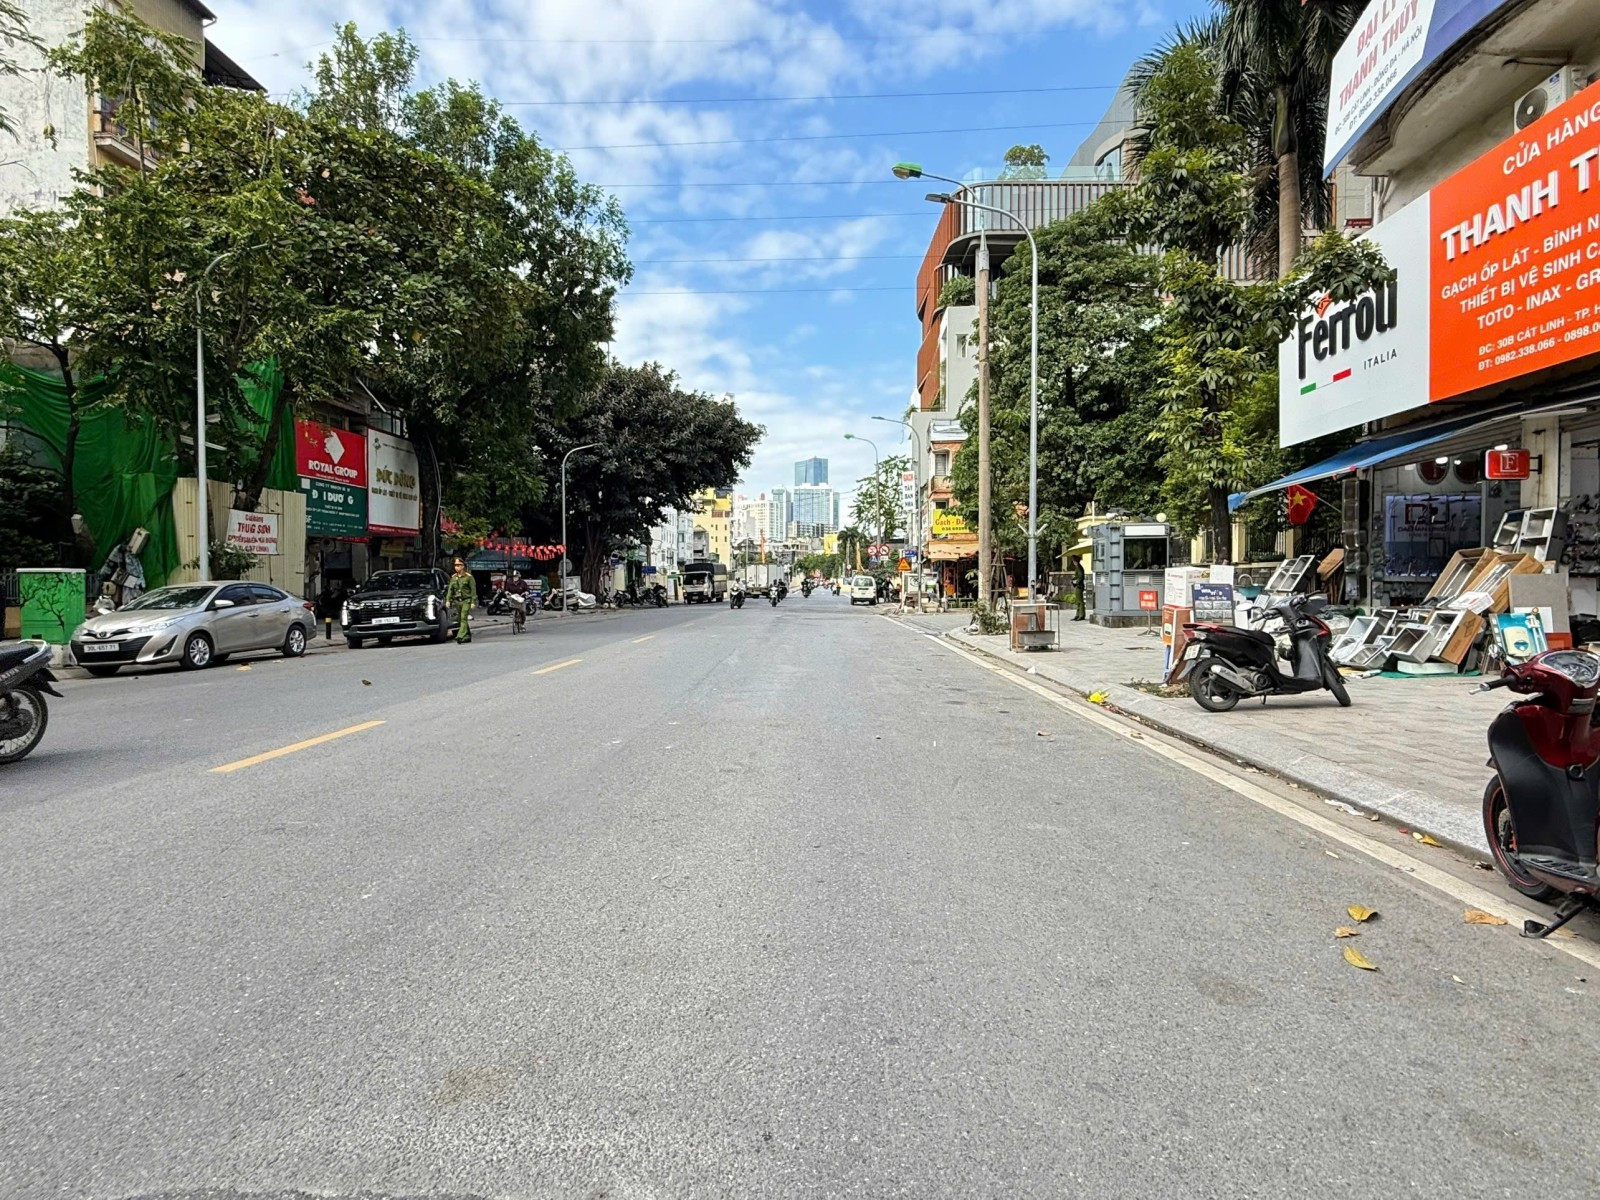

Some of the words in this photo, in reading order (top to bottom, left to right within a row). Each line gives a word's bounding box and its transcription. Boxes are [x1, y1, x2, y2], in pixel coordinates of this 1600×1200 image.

[1339, 44, 1378, 111] THANH
[1503, 141, 1541, 175] CỬA
[1440, 170, 1559, 261] THANH
[1441, 272, 1477, 299] GẠCH
[1480, 260, 1499, 282] ỐP
[1502, 247, 1530, 272] LÁT
[1543, 222, 1582, 253] BÌNH
[1460, 285, 1497, 313] THIẾT
[1501, 279, 1515, 297] BỊ
[1519, 266, 1539, 289] VỆ
[1543, 249, 1581, 278] SINH
[1477, 304, 1514, 329] TOTO
[1526, 284, 1562, 311] INAX
[1478, 343, 1494, 355] ĐC:
[1497, 336, 1514, 350] 30B
[1517, 326, 1537, 342] CÁT
[1540, 317, 1565, 334] LINH
[1575, 307, 1591, 321] TP.
[1478, 359, 1493, 371] ĐT:
[1495, 337, 1555, 366] 0982.338.066
[1364, 348, 1397, 370] ITALIA
[308, 460, 334, 474] ROYAL
[334, 466, 358, 479] GROUP
